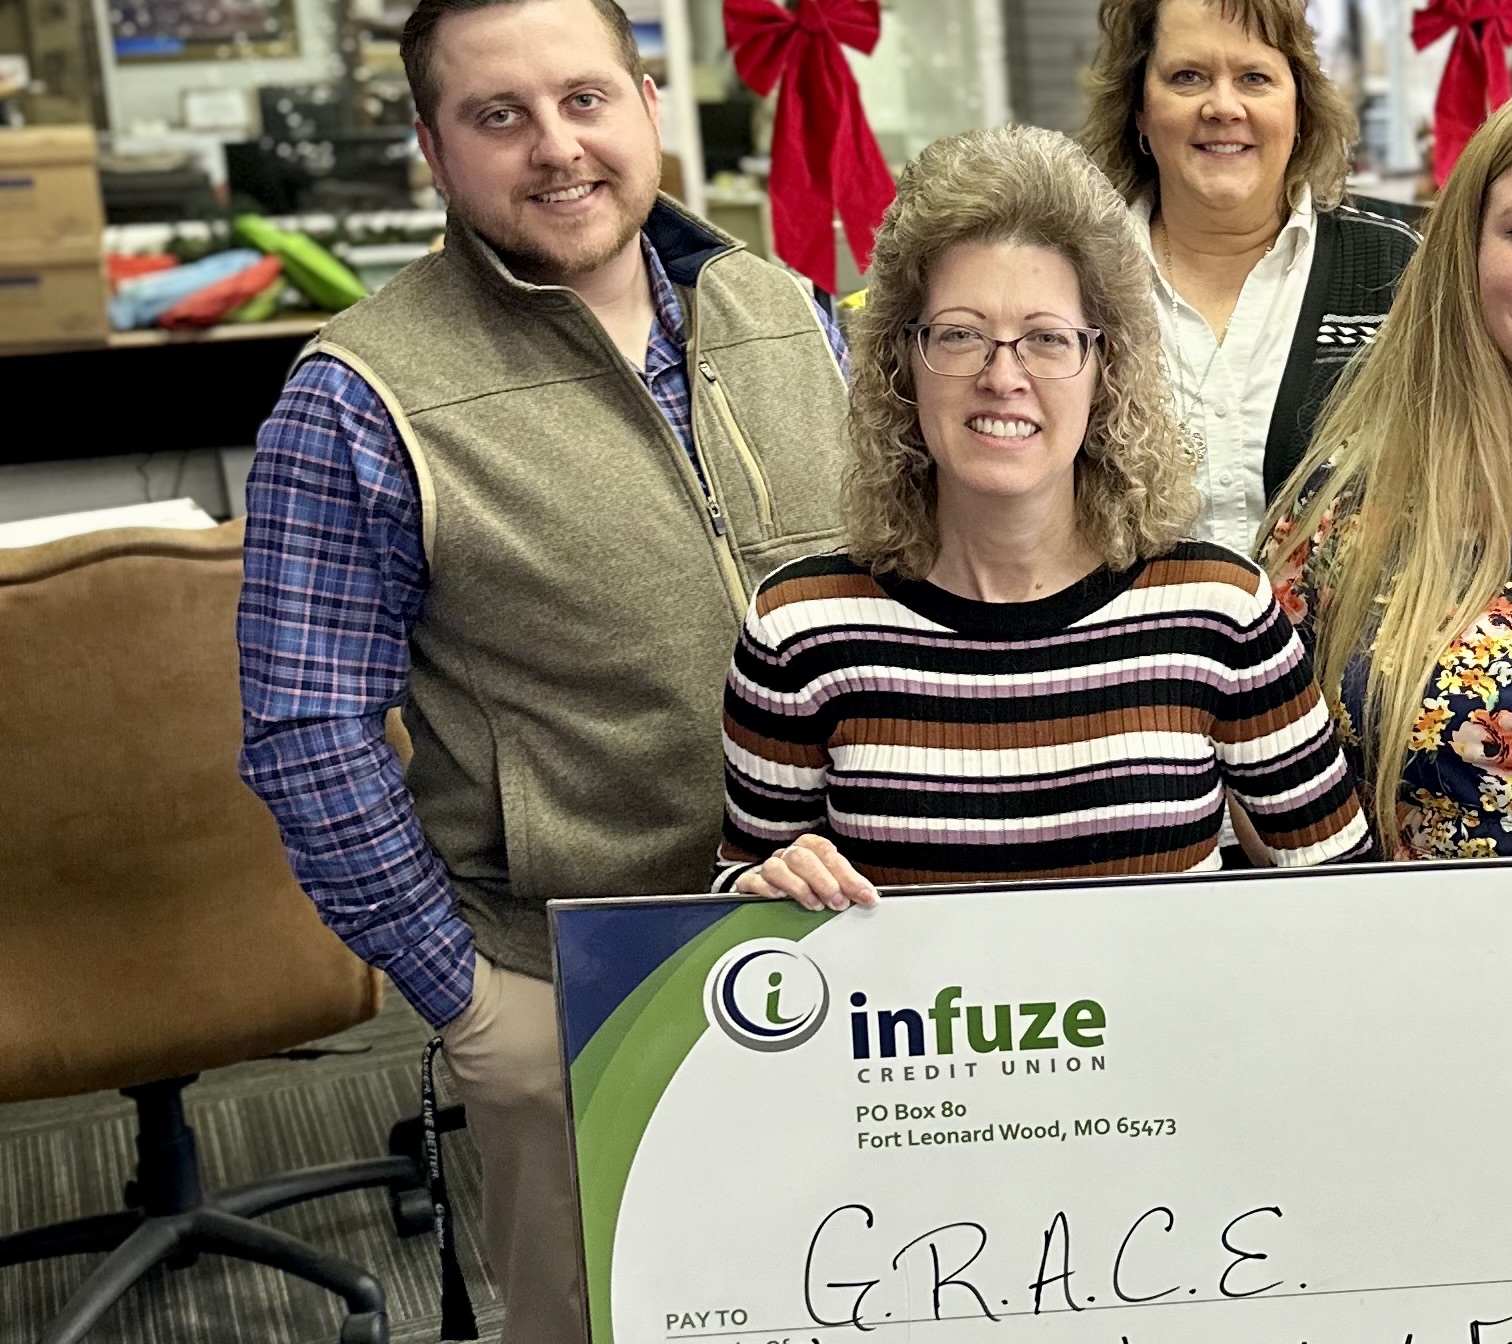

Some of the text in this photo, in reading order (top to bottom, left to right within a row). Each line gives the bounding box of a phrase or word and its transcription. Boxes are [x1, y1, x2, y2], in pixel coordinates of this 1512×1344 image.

[849, 987, 1107, 1061] infuze
[857, 1055, 1107, 1084] CREDIT UNION
[856, 1100, 967, 1123] PO Box 80
[858, 1116, 1177, 1150] Fort Leonard Wood, MO 65473
[803, 1203, 1308, 1332] G.R.A.C.E.
[666, 1308, 748, 1331] PAY TO
